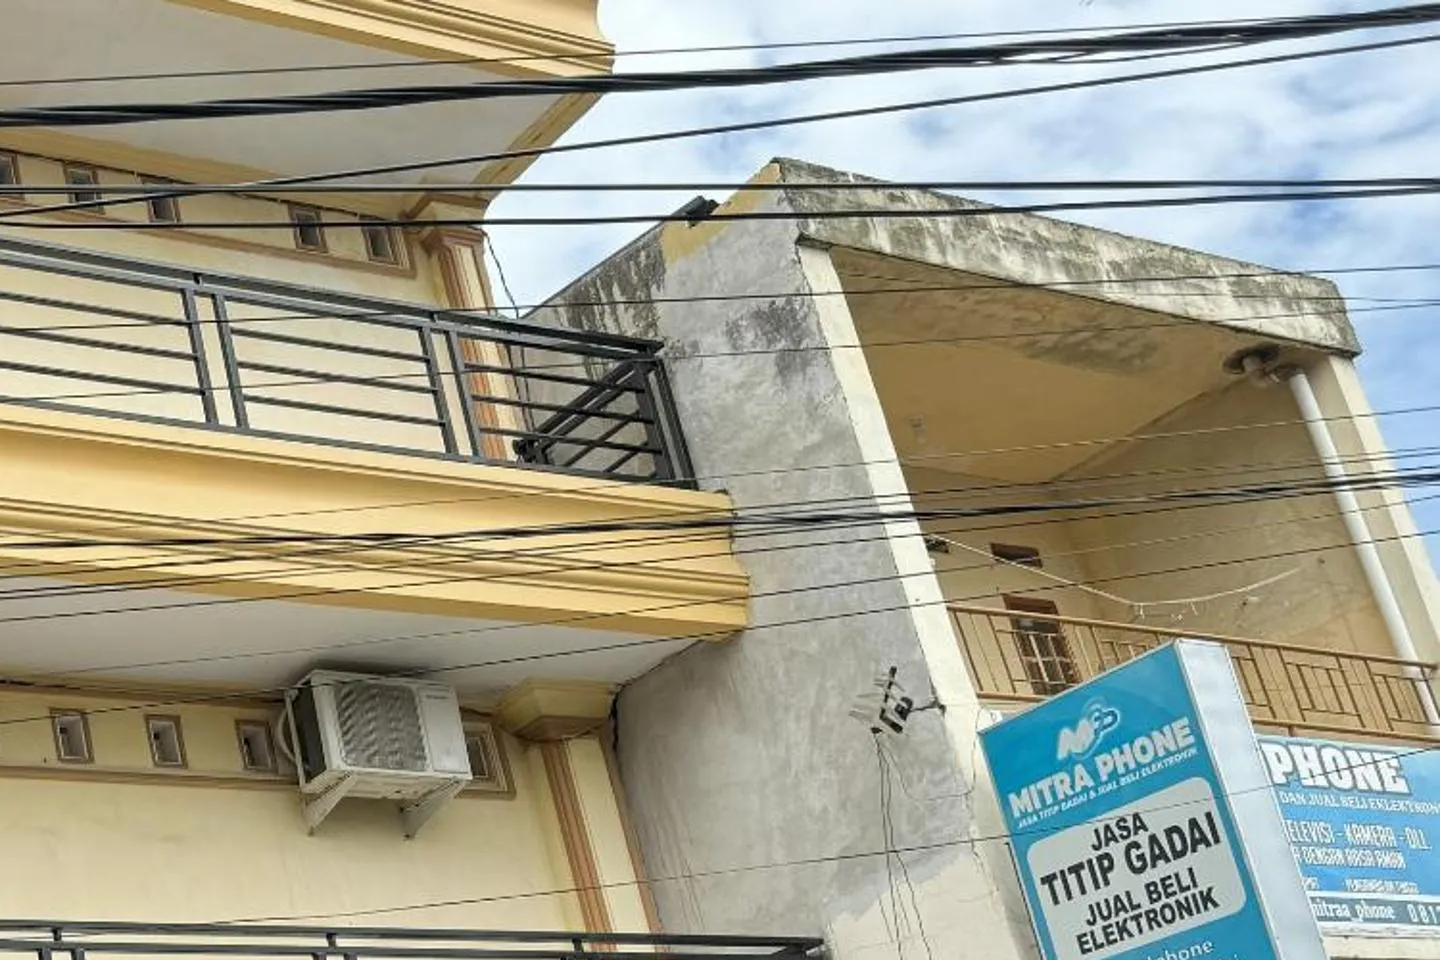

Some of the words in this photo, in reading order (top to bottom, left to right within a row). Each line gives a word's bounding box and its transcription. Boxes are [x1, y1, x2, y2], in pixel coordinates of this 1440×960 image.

[1008, 764, 1095, 818] MITRA
[1094, 716, 1195, 781] PHONE
[1260, 743, 1410, 793] PHONE
[1040, 851, 1115, 906] TITIP
[1124, 812, 1221, 874] GADAI
[1091, 812, 1149, 851] JASA
[1076, 886, 1220, 955] ELEKTRONIK
[1086, 890, 1141, 926] JUAL
[1145, 867, 1199, 905] BELI
